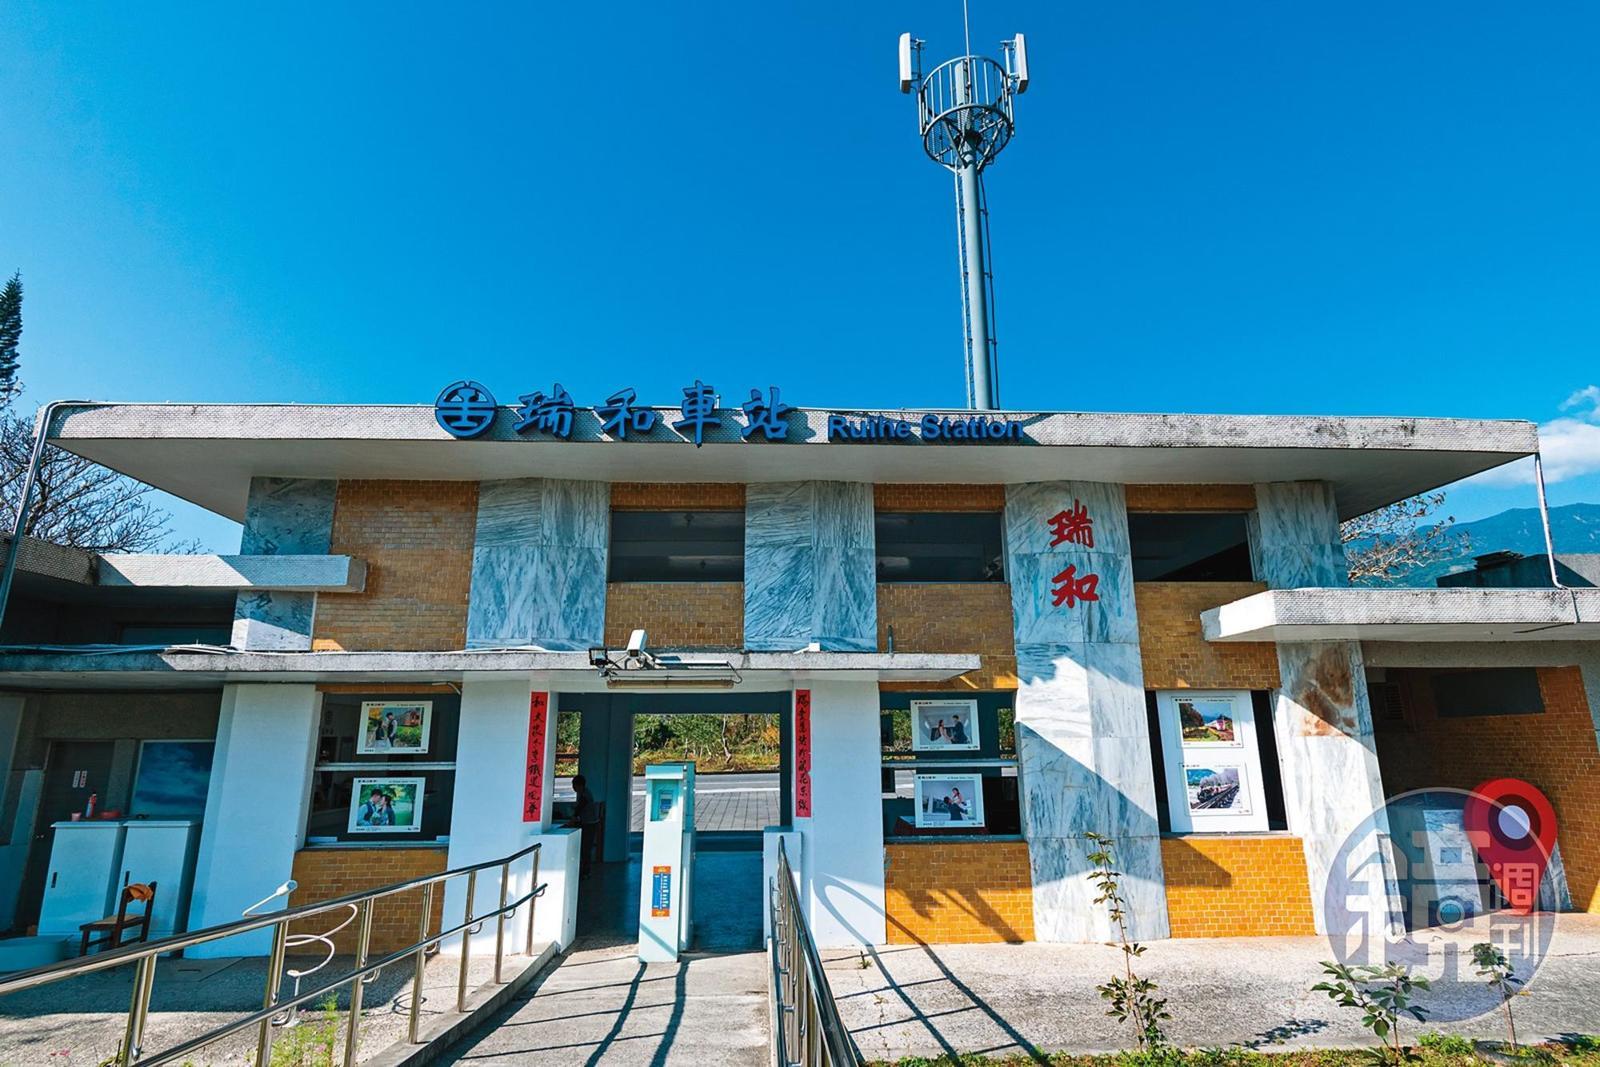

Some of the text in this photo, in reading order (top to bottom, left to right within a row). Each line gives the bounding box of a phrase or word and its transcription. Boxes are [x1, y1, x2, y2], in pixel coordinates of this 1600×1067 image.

[511, 380, 790, 448] 瑞和車站
[827, 413, 1024, 441] Ruihe Station
[1047, 498, 1099, 609] 瑞和
